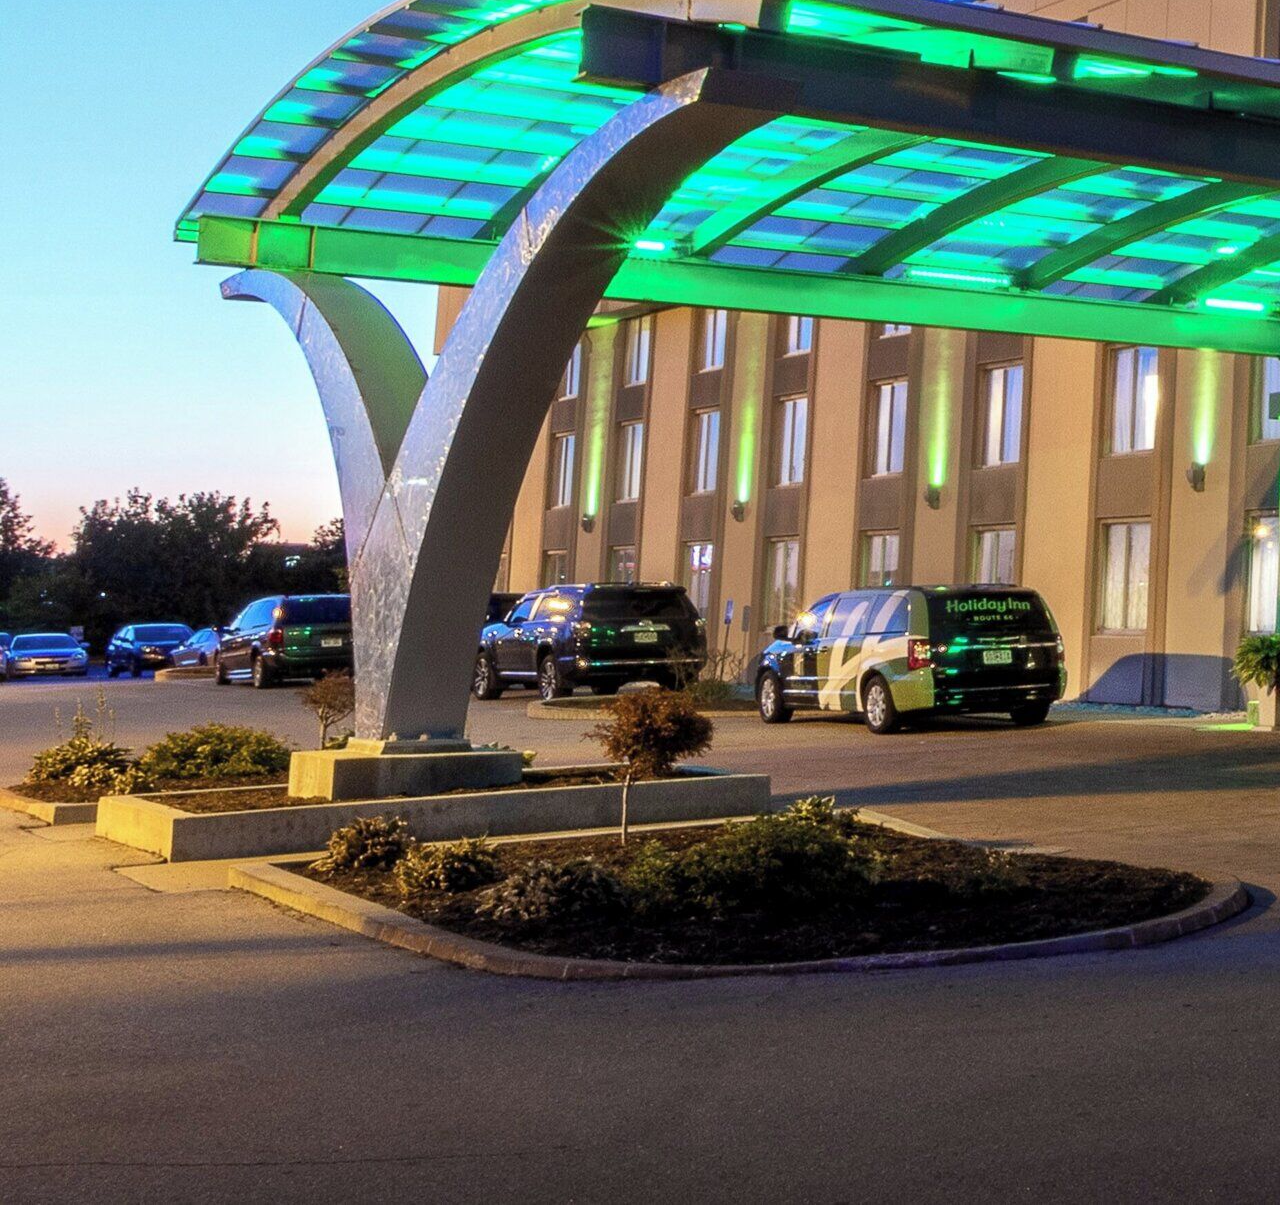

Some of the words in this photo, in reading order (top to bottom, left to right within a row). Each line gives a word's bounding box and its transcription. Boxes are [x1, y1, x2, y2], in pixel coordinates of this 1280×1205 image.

[945, 597, 1006, 613] Holiday
[1008, 597, 1031, 610] Inn
[973, 614, 1001, 622] ROUTE
